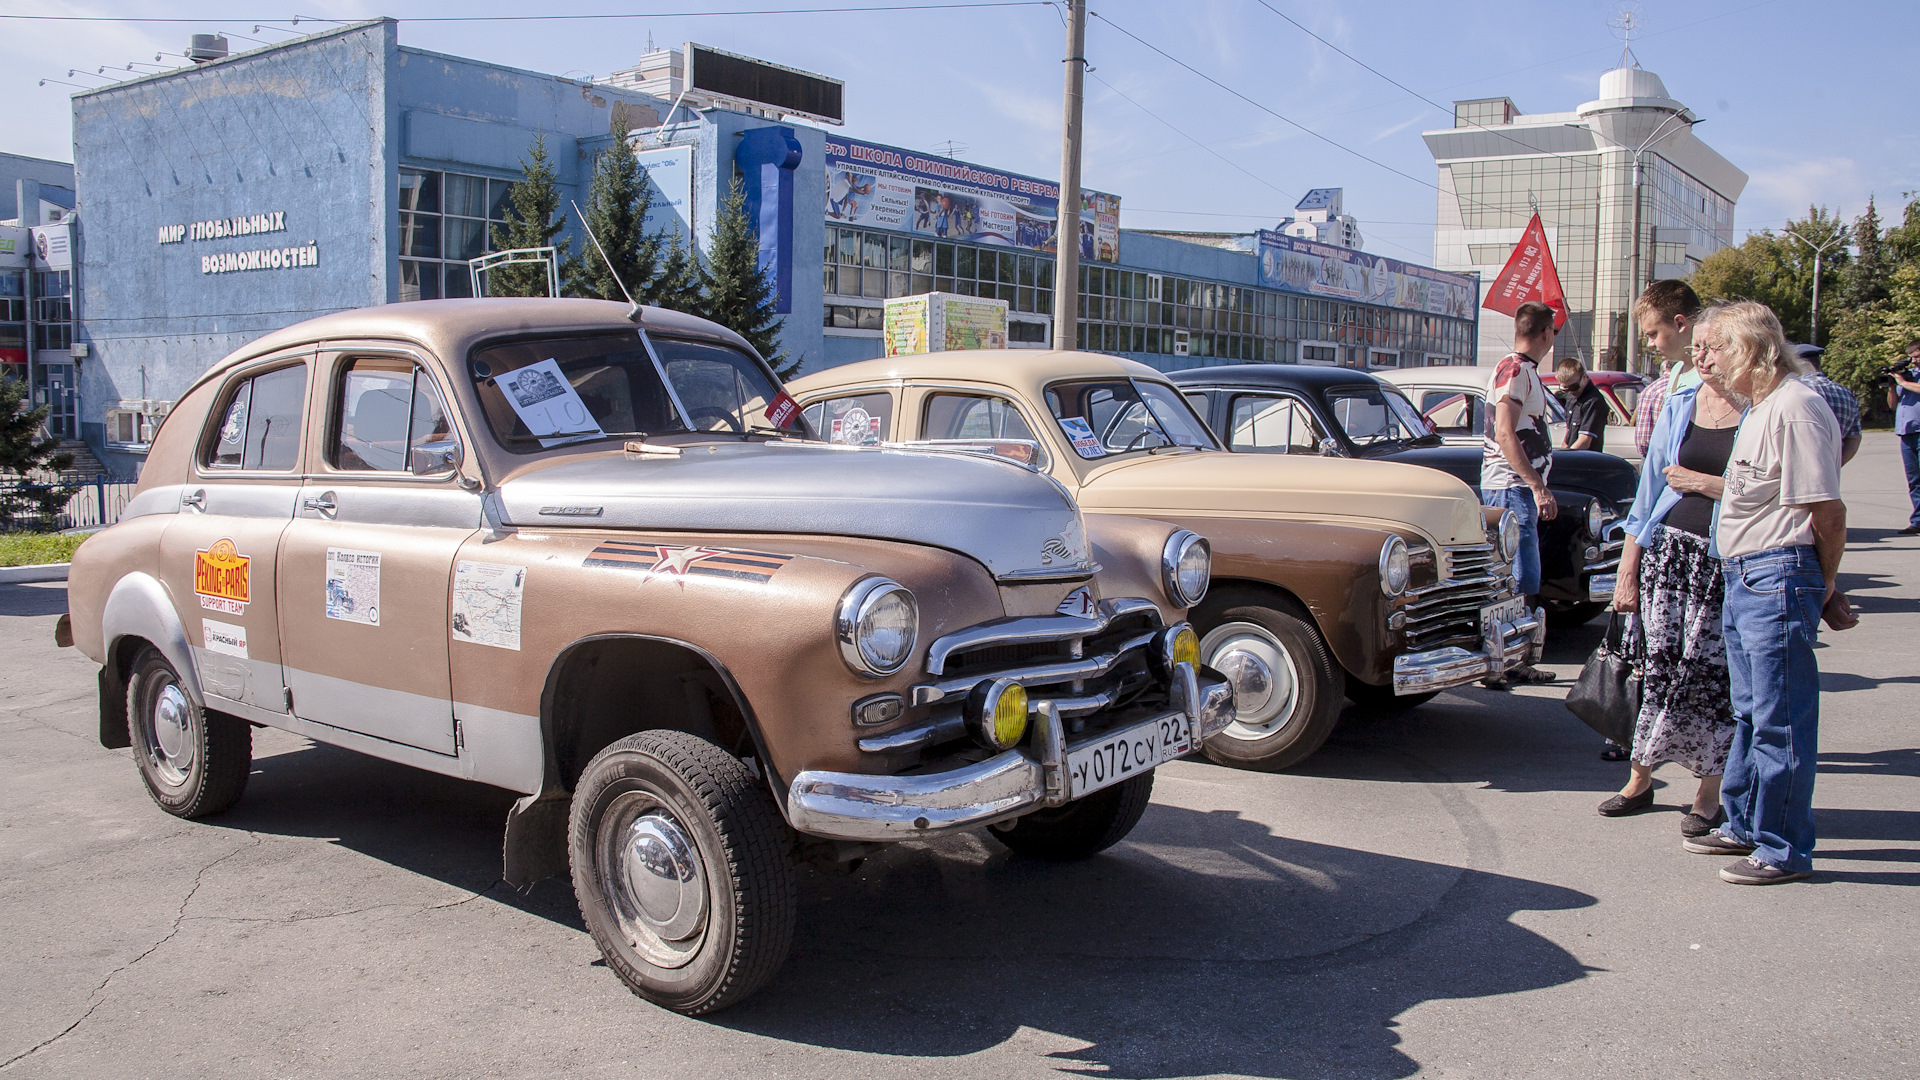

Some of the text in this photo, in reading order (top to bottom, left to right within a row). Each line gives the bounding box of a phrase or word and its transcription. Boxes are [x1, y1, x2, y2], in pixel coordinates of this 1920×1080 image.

[837, 162, 877, 176] УПРАВЛЕНИЕ
[879, 169, 916, 184] АЛТАЙСКОГО
[918, 178, 932, 187] КРАЯ
[943, 182, 979, 196] ФИЗИЧЕСКОЙ
[980, 190, 1005, 200] КУЛЬТУРЕ
[1011, 195, 1029, 205] СПОРТУ
[850, 145, 902, 168] ШКОЛА
[905, 157, 1009, 189] ОЛИМПИЙСКОГО
[1011, 179, 1060, 199] РЕЗЕРВА
[158, 211, 285, 243] МИР ГЛОБАЛЬНЫХ
[980, 209, 989, 217] МЫ
[982, 220, 1013, 232] Мастеров!
[202, 239, 318, 273] ВОЗМОЖНОСТЕЙ
[1078, 446, 1103, 456] 70 ЛЕТ
[196, 554, 248, 598] PEKING-PARIS
[202, 596, 243, 613] SUPPORT TEAM
[212, 633, 237, 647] КРАСНЫЙ
[239, 640, 246, 648] ЯР
[1161, 718, 1183, 746] 22
[1162, 745, 1178, 757] RUS
[593, 921, 642, 986] STUDLESS
